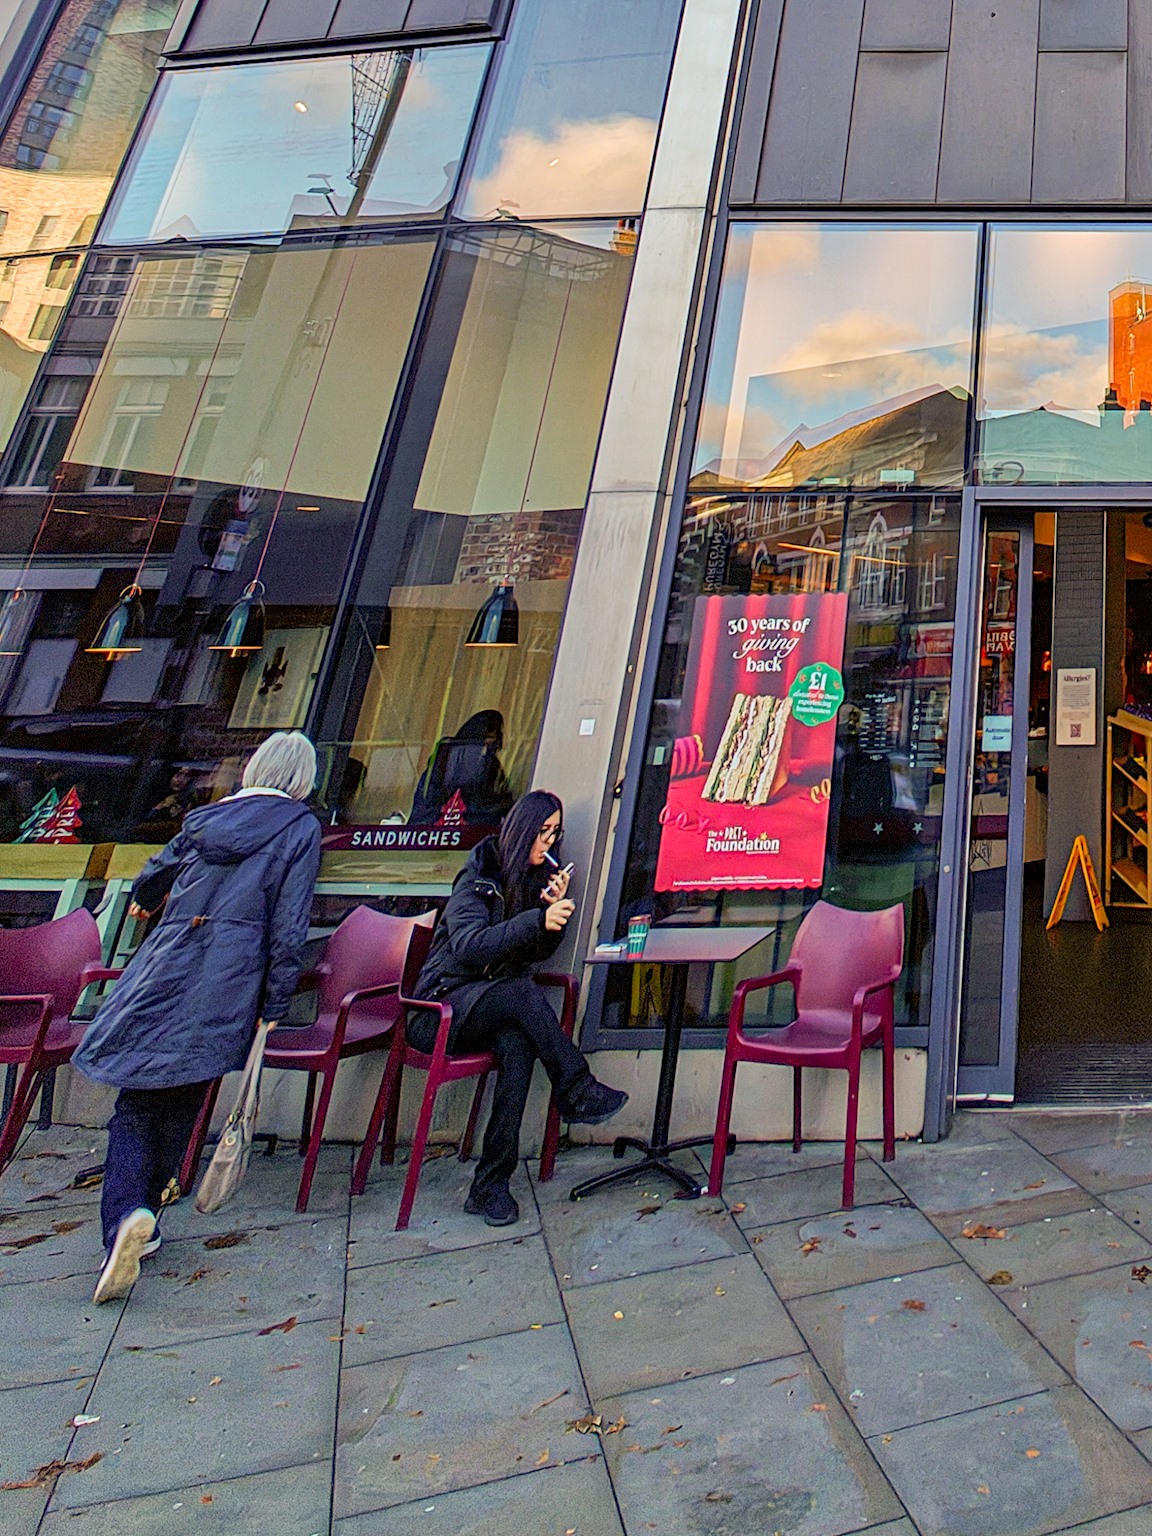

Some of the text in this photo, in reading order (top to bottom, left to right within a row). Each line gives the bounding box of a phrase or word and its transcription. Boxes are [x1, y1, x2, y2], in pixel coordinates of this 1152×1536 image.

[728, 617, 810, 636] 30 years of
[733, 634, 800, 659] giving
[745, 655, 783, 673] back
[808, 671, 827, 690] £1
[351, 830, 461, 846] SANDWICHES
[724, 826, 742, 840] PRET
[706, 836, 780, 853] Foundation
